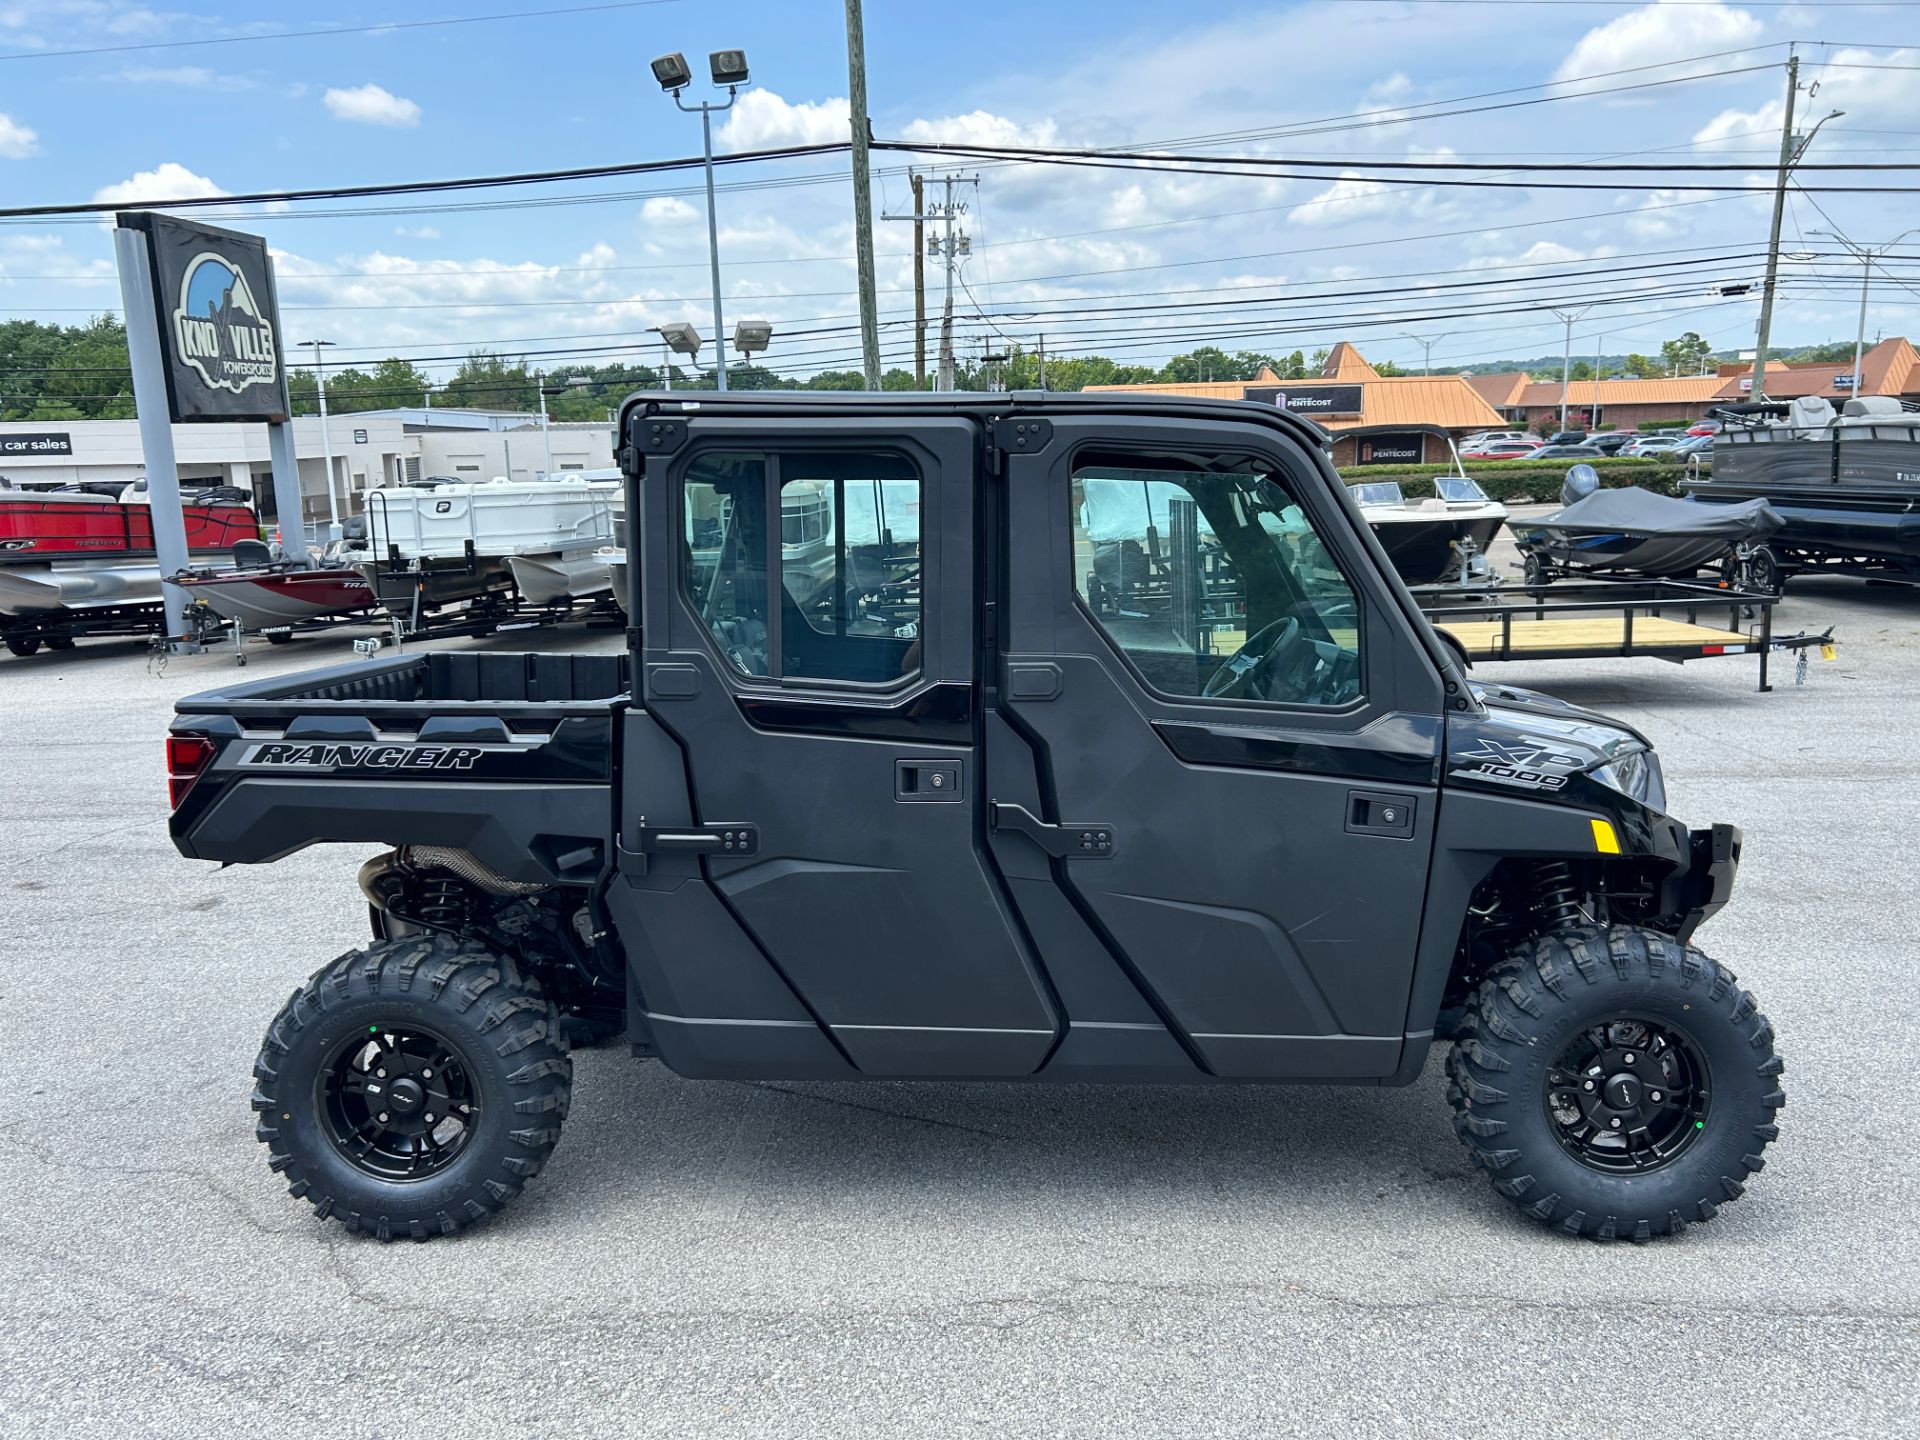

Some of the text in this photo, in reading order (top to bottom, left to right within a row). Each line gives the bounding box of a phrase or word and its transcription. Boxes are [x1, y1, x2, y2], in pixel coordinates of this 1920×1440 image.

[222, 361, 273, 377] POWERSPORTS
[1287, 399, 1333, 407] PENTECOST
[5, 441, 28, 450] car
[30, 438, 68, 450] sales
[1373, 450, 1417, 458] PENTECOST
[260, 626, 291, 634] TRACKER
[248, 742, 483, 770] RANGER
[1455, 738, 1588, 769] XP
[1480, 763, 1568, 788] 1000
